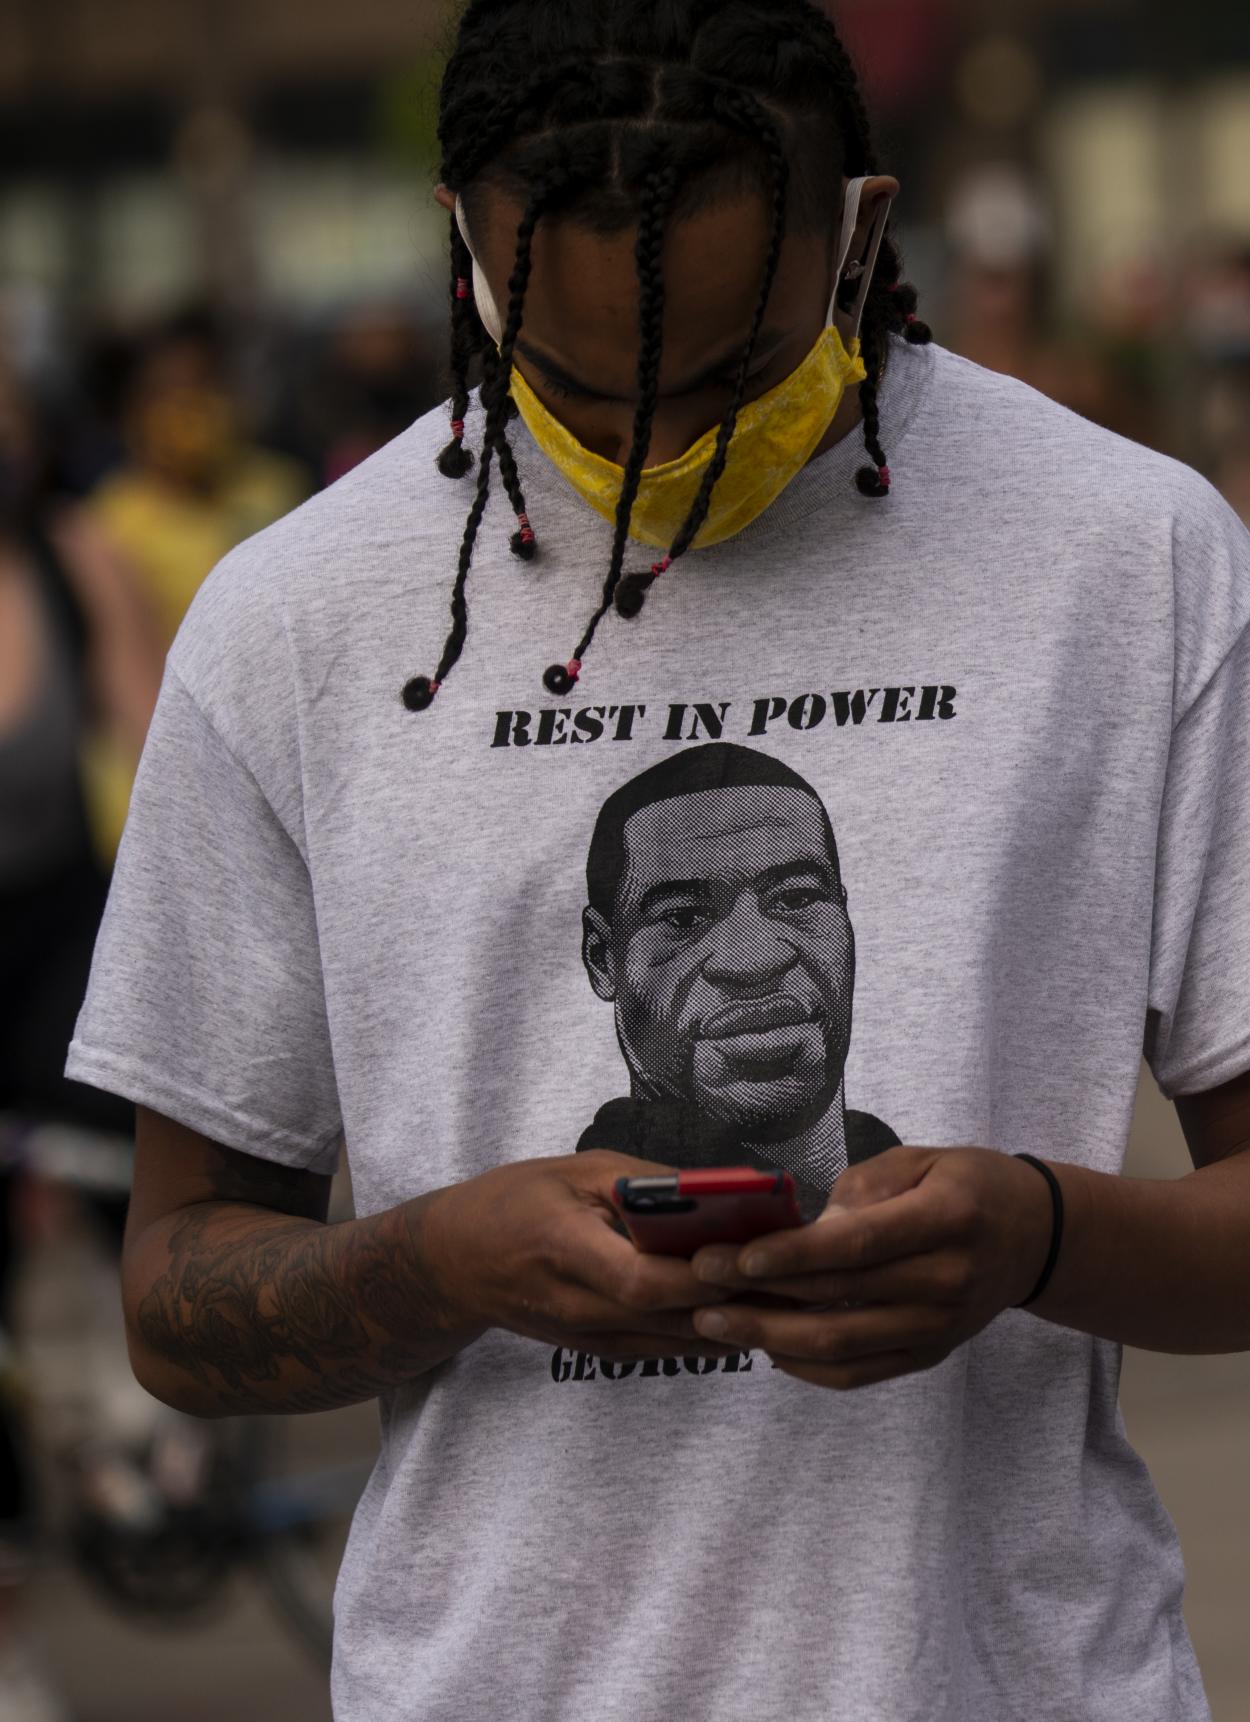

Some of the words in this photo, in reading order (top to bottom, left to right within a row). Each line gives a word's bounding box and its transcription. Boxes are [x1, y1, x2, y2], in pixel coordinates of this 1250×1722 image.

[490, 705, 646, 748] REST
[662, 702, 733, 741] IN
[747, 685, 957, 736] POWER
